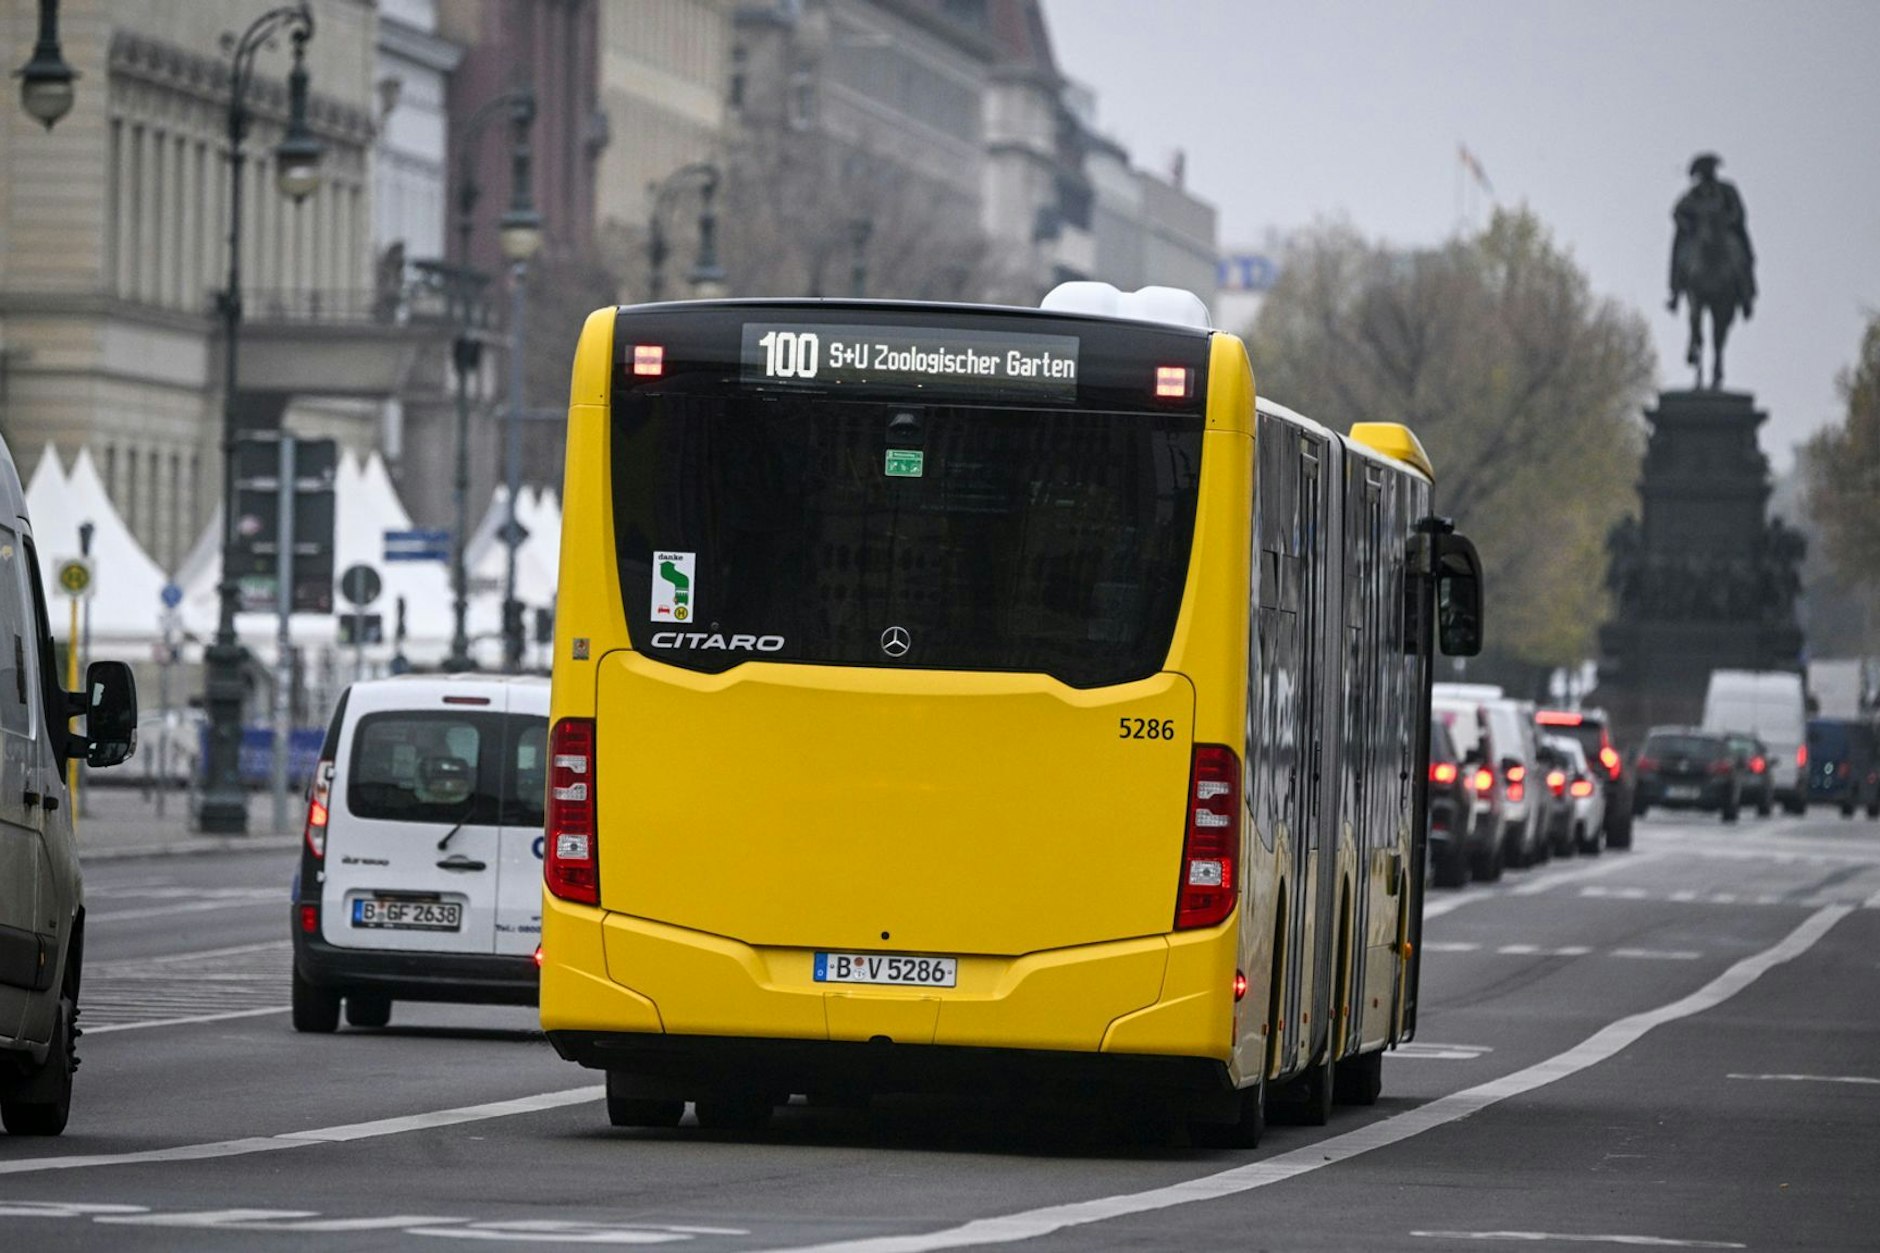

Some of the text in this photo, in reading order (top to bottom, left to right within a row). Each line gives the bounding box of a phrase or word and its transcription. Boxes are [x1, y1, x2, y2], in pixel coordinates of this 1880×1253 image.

[759, 331, 819, 378] 100
[829, 342, 1075, 378] S+U Zoologischer Garten
[650, 632, 785, 652] CITARO
[1119, 717, 1175, 740] 5286
[364, 903, 457, 923] B GF 2638
[836, 956, 946, 983] B V 5286
